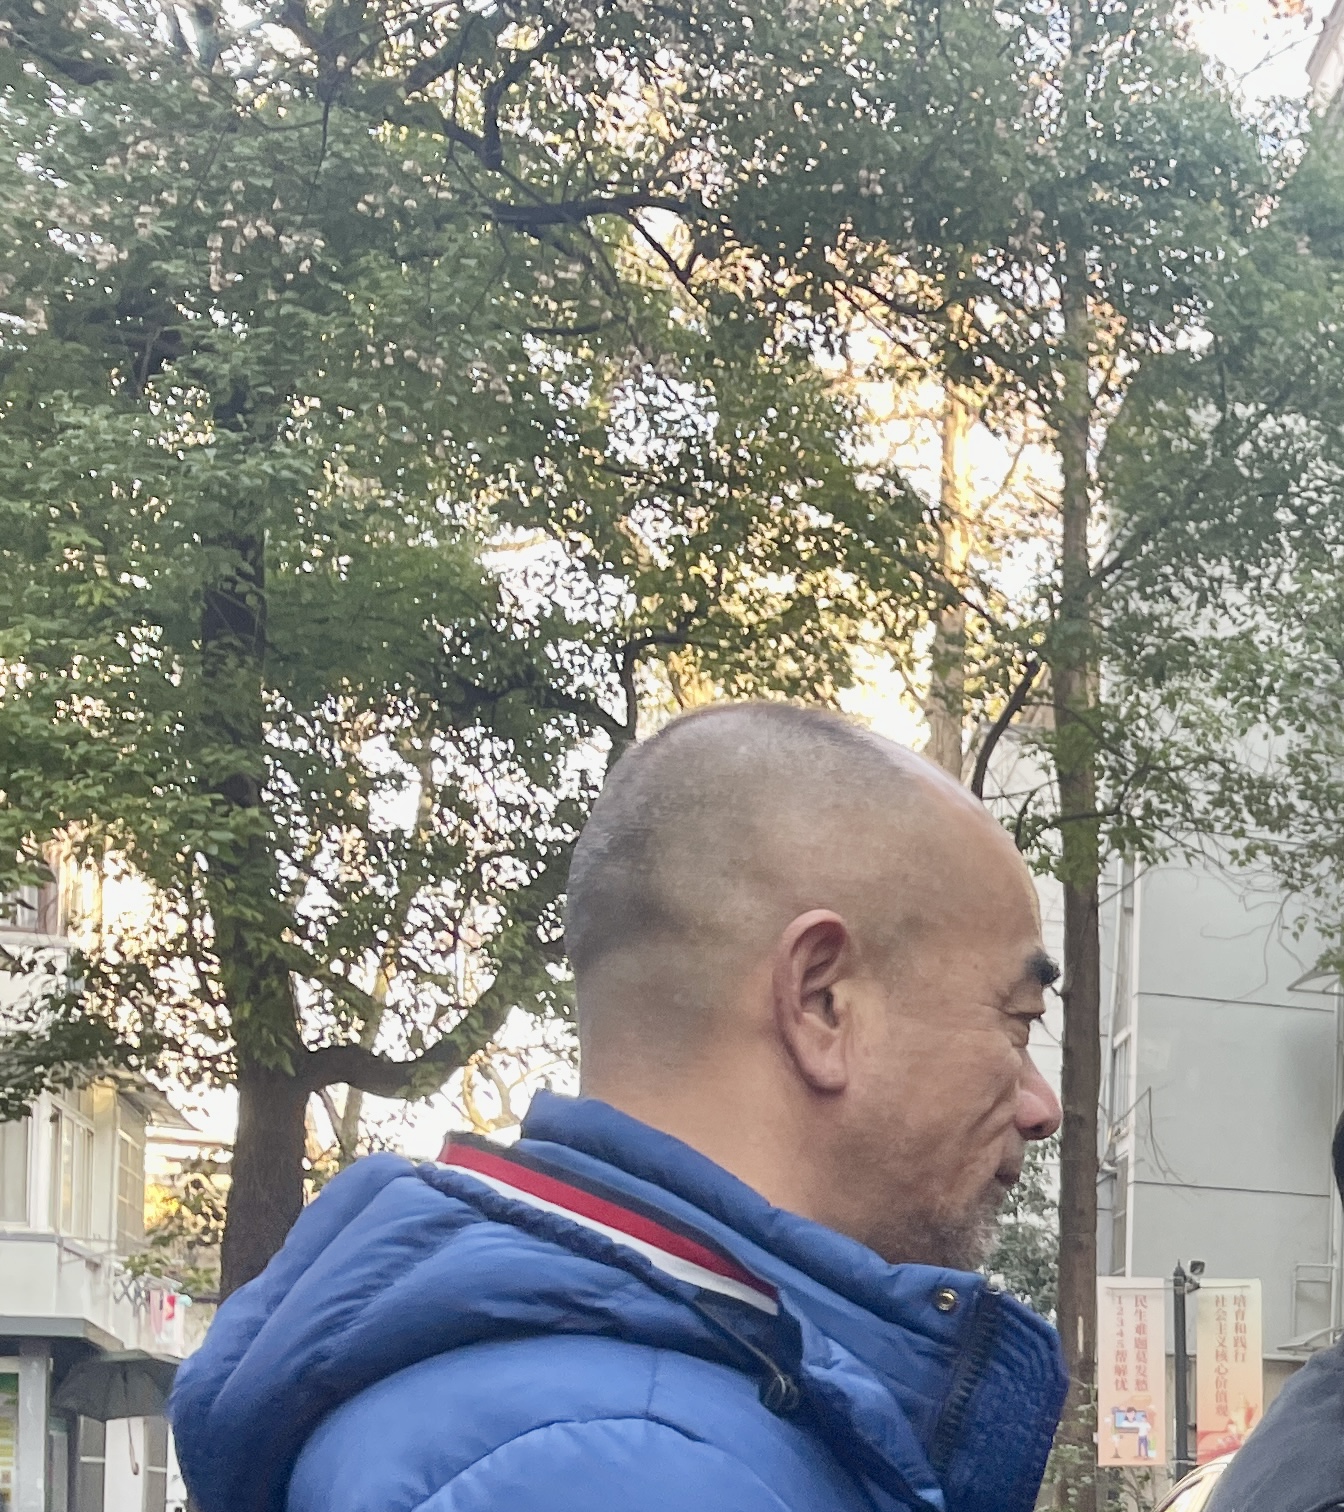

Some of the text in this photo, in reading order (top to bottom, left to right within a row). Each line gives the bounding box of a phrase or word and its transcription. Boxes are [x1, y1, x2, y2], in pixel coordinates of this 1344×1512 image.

[1114, 1295, 1128, 1392] 12345帮解忧
[1134, 1294, 1148, 1391] 民生难题莫发愁
[1214, 1295, 1229, 1417] 社会主义核心价值观
[1233, 1294, 1247, 1363] 培育和践行
